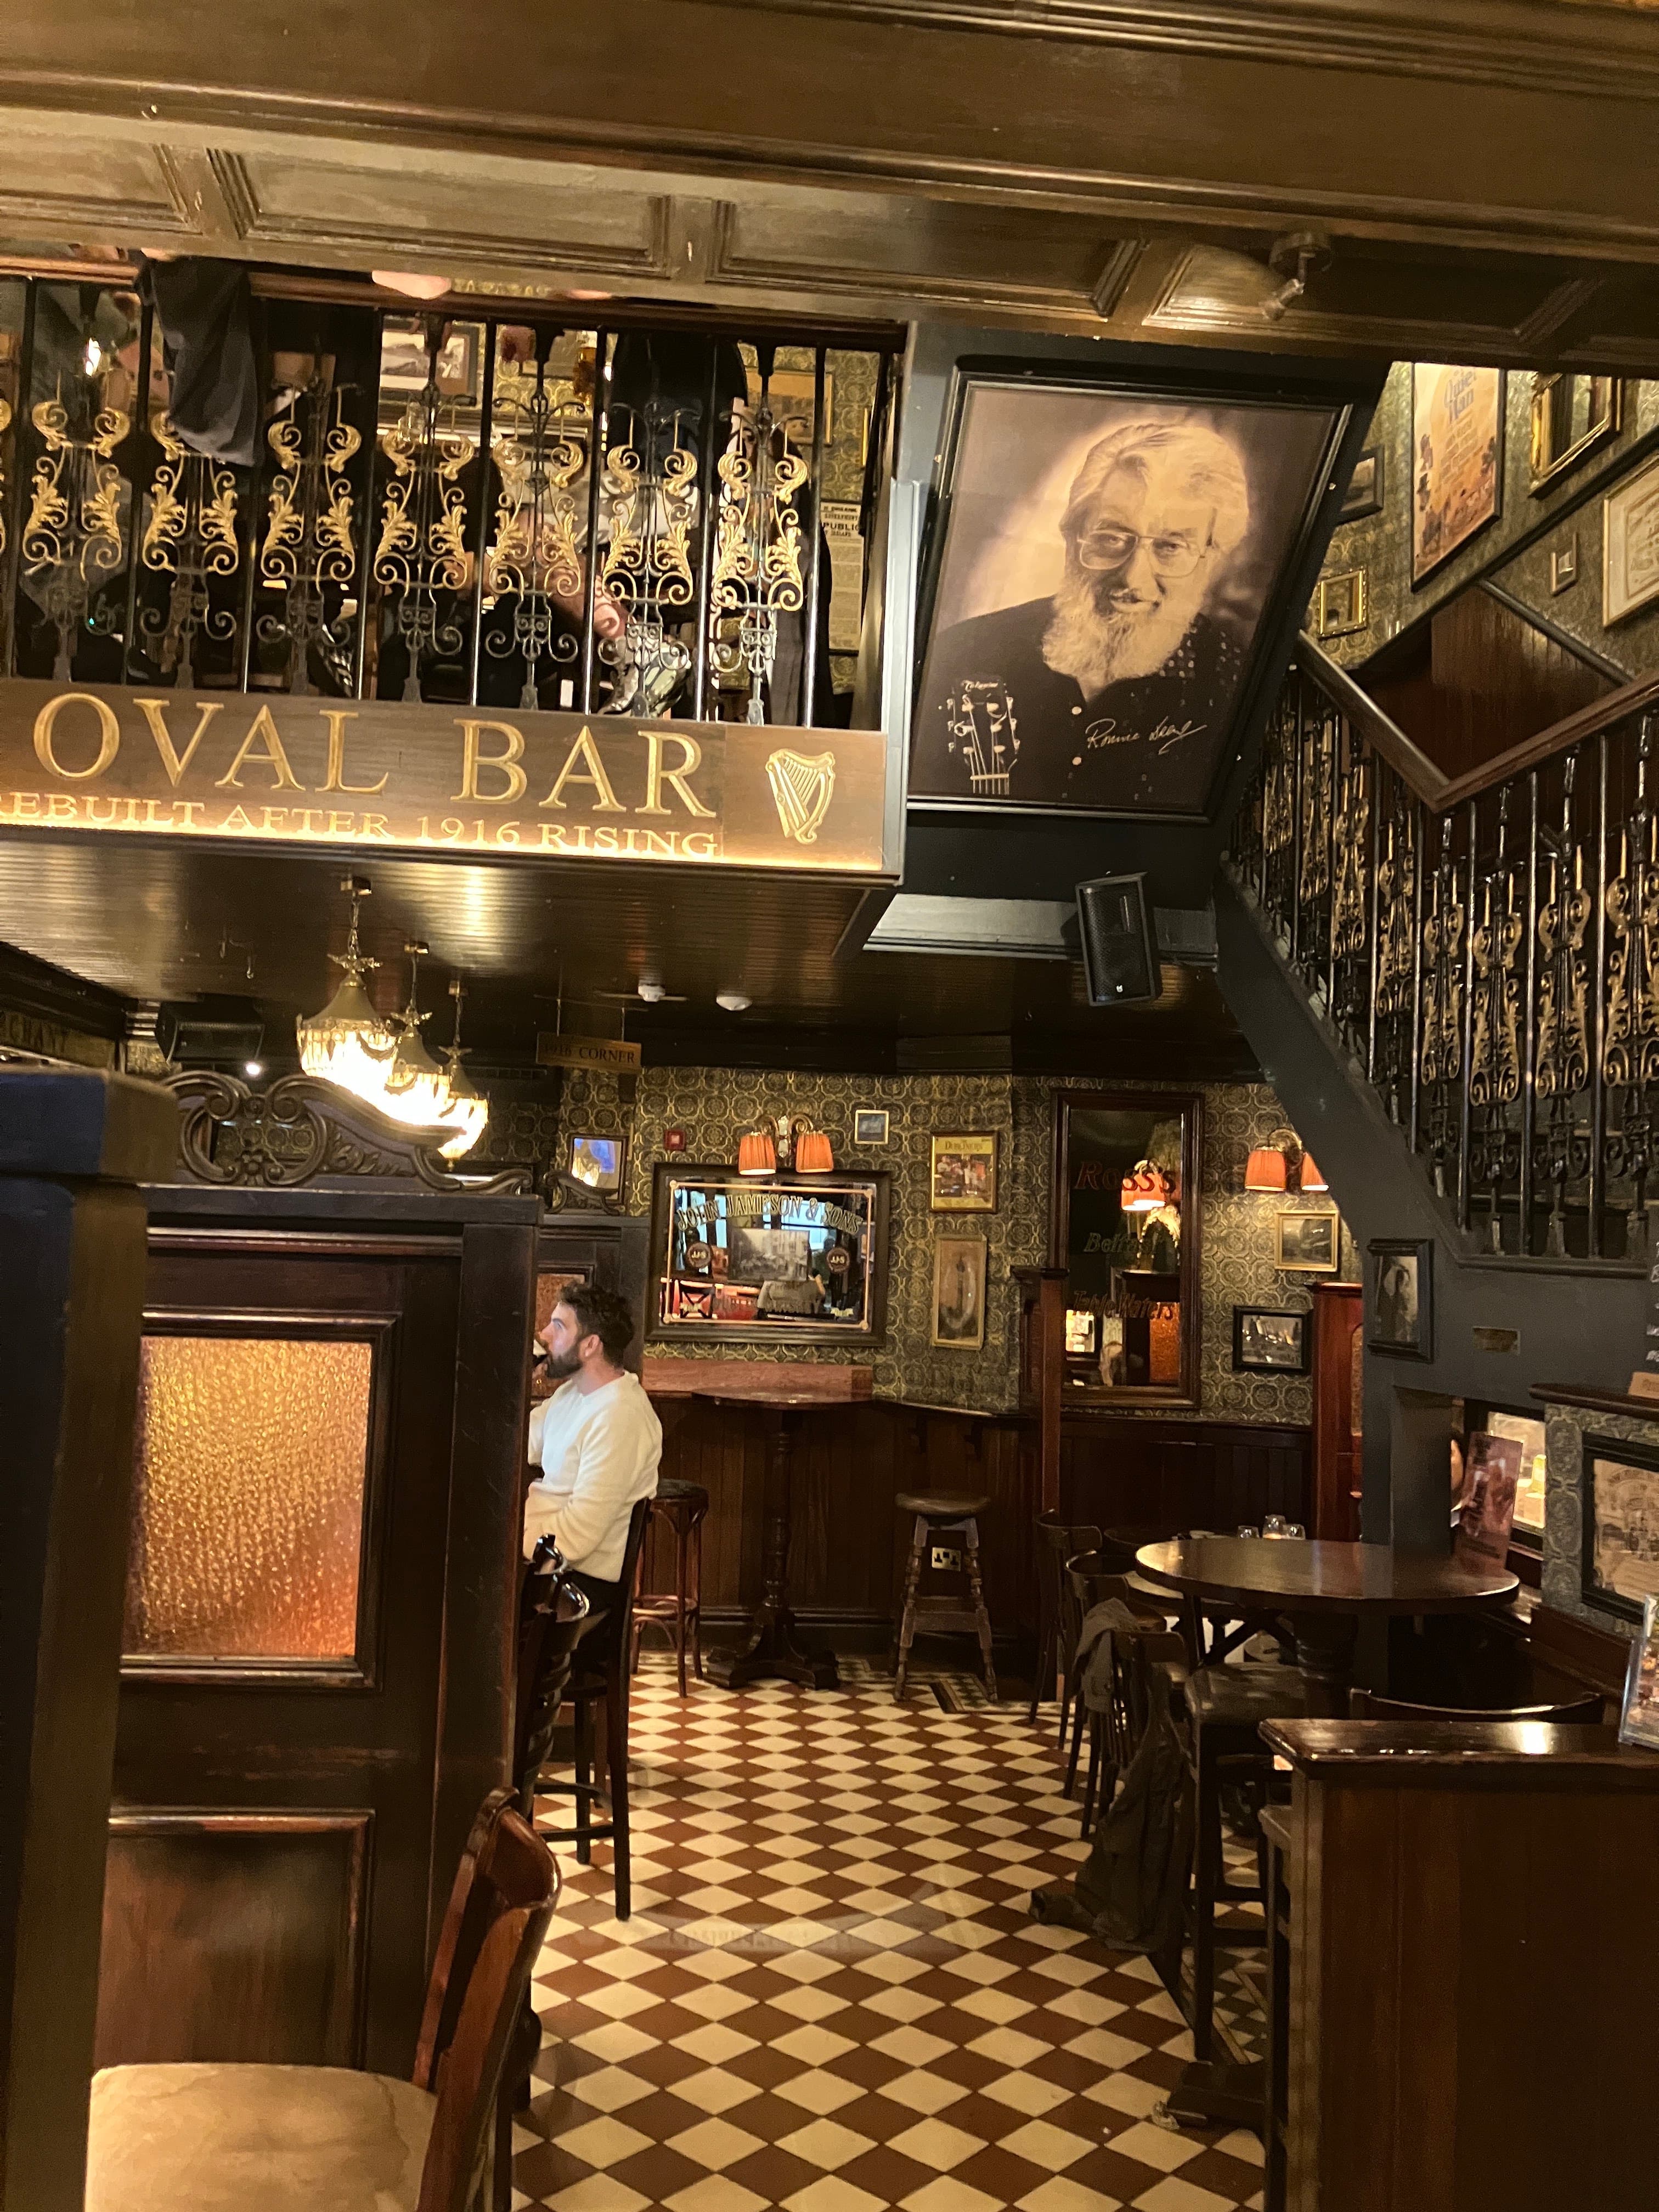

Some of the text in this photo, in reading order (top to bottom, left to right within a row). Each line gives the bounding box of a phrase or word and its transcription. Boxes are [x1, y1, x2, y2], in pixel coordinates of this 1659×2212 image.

[33, 692, 717, 818] OVAL BAR
[218, 804, 396, 839] AFTER
[417, 815, 521, 848] 1916
[536, 823, 719, 858] RISING
[579, 1047, 635, 1064] CORNER
[676, 1193, 863, 1234] JOHN JAMESON & SONS
[1074, 1290, 1115, 1319] Table
